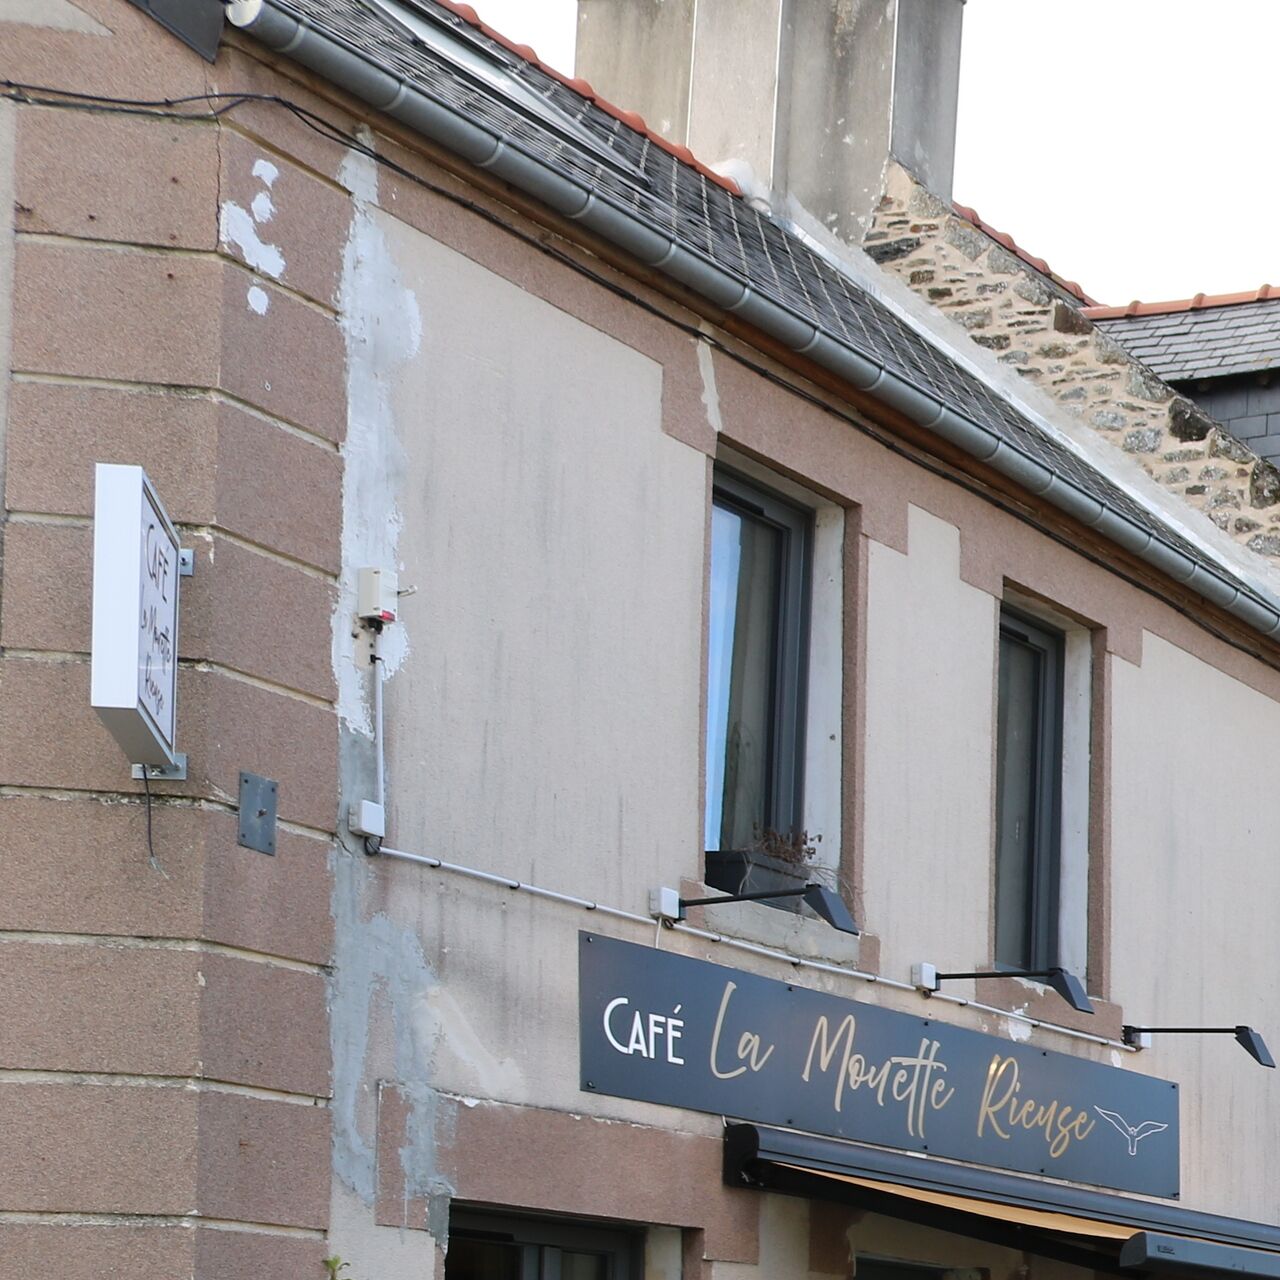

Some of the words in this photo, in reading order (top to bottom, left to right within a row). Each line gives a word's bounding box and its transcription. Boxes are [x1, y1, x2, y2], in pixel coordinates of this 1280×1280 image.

[603, 996, 685, 1066] CAFÉ
[709, 981, 774, 1078] La
[802, 1014, 955, 1138] Mouette
[977, 1053, 1096, 1158] Rieuse
